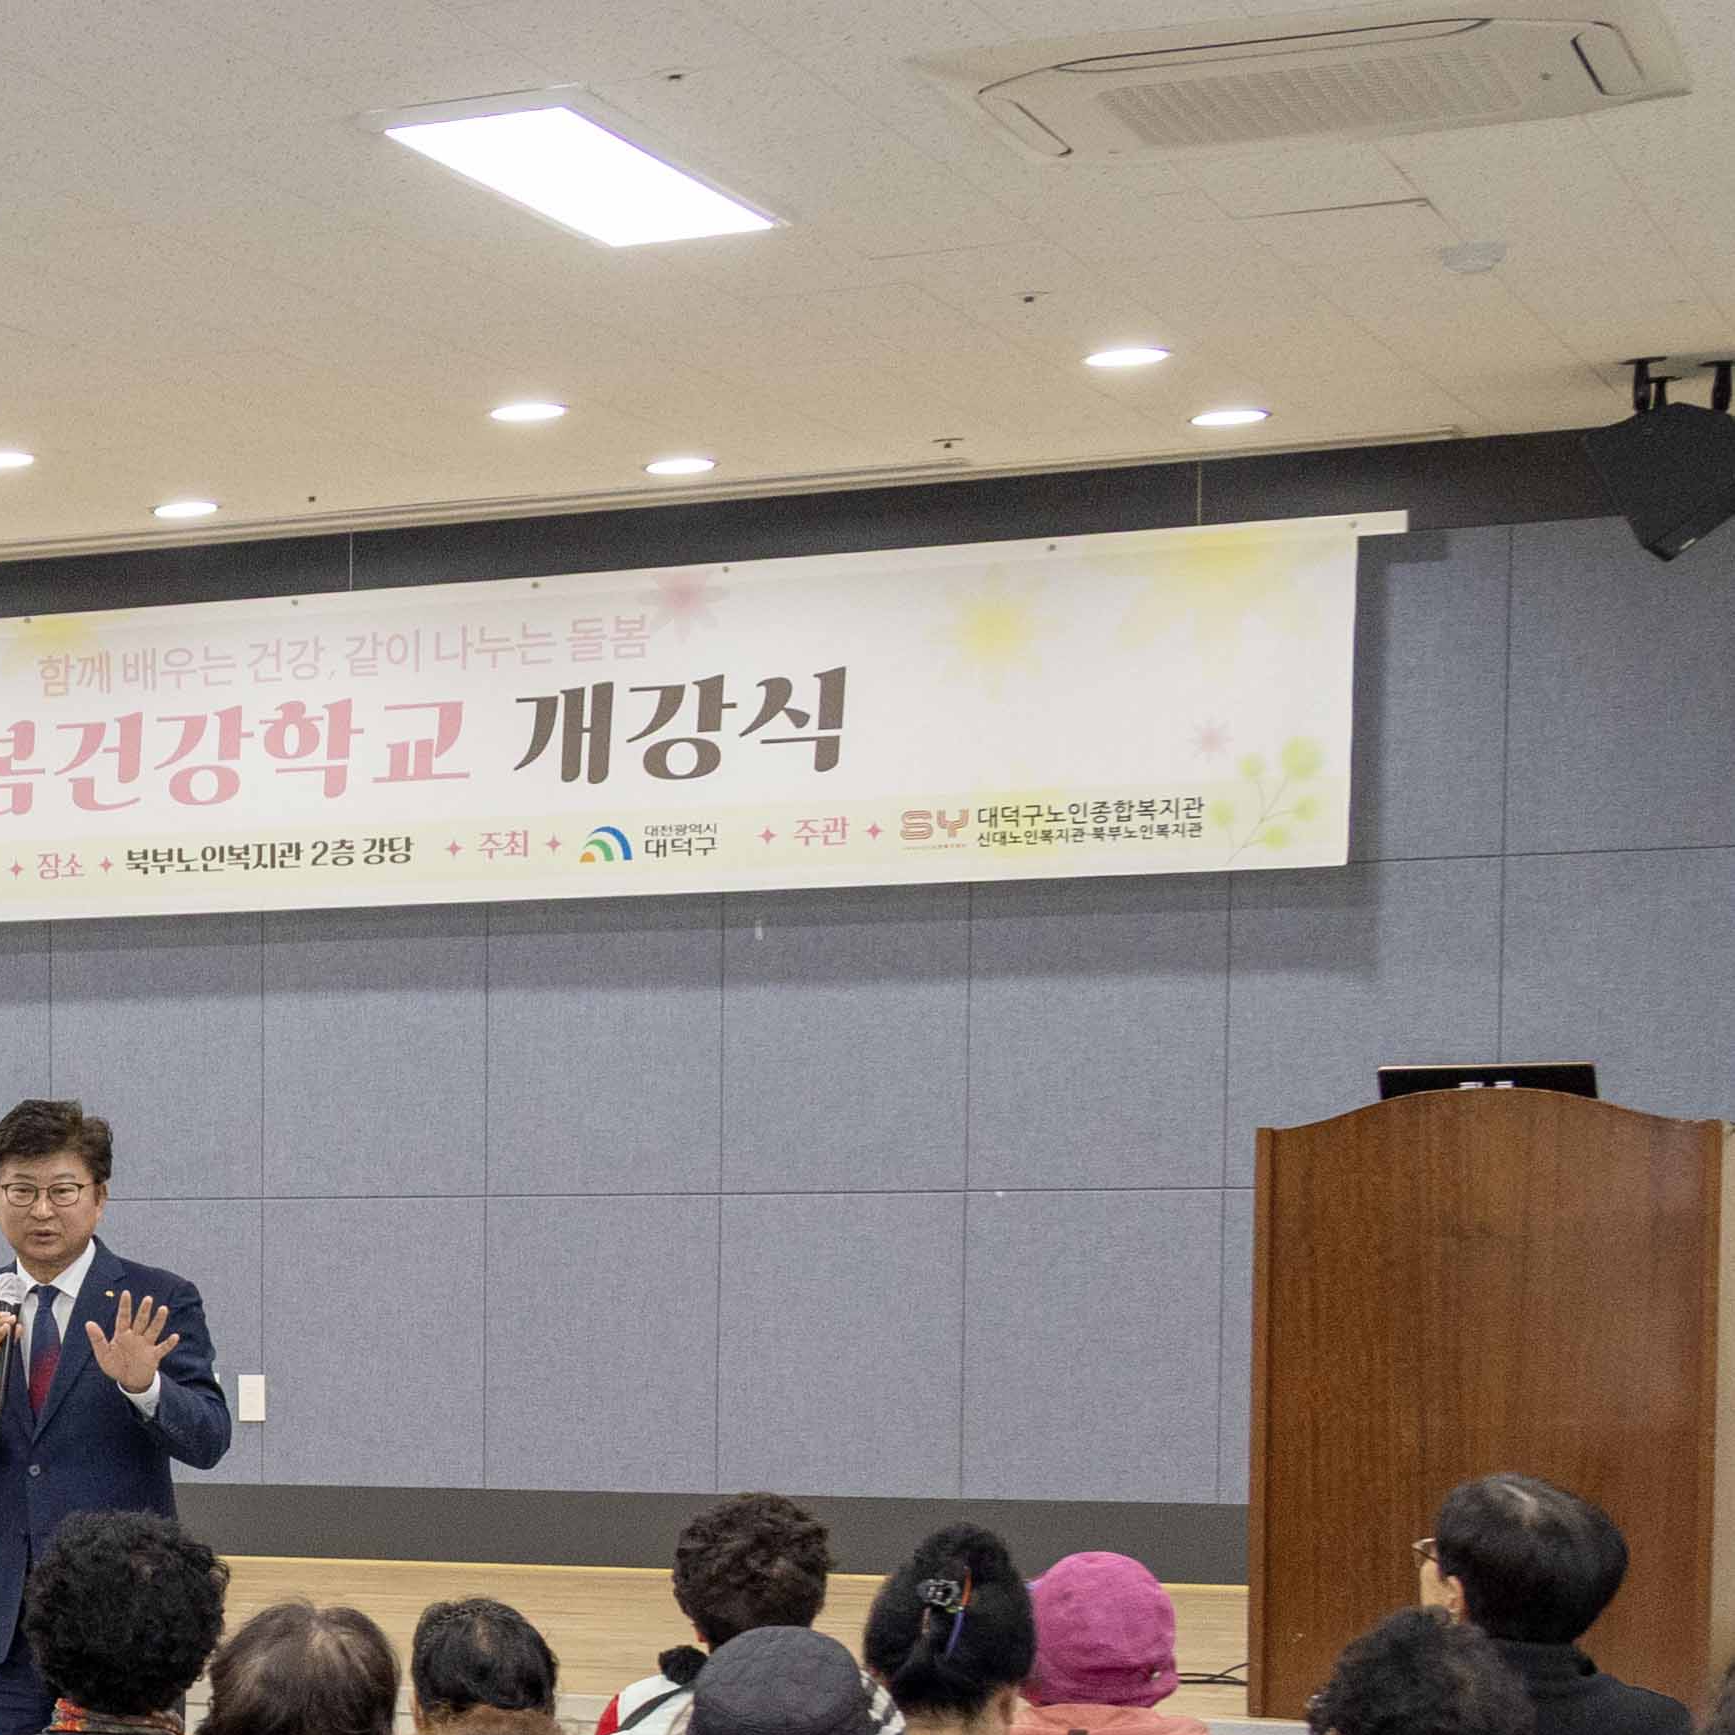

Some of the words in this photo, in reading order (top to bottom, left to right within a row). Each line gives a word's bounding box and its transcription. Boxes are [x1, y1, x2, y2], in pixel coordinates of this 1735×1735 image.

[38, 651, 112, 698] 함께
[122, 645, 237, 692] 배우는
[342, 630, 423, 676] 같이
[434, 624, 558, 670] 나누는
[567, 614, 651, 662] 돌봄
[514, 666, 850, 785] 개강식
[977, 797, 1205, 829] 대덕구노인종합복지관
[477, 829, 530, 859] 주최
[643, 823, 718, 836] 대전광역시
[793, 816, 850, 847] 주관
[36, 852, 85, 880] 장소
[125, 840, 304, 876] 북부노인복지관
[311, 839, 356, 867] 2층
[362, 836, 415, 865] 강당
[644, 836, 718, 858] 대덕구
